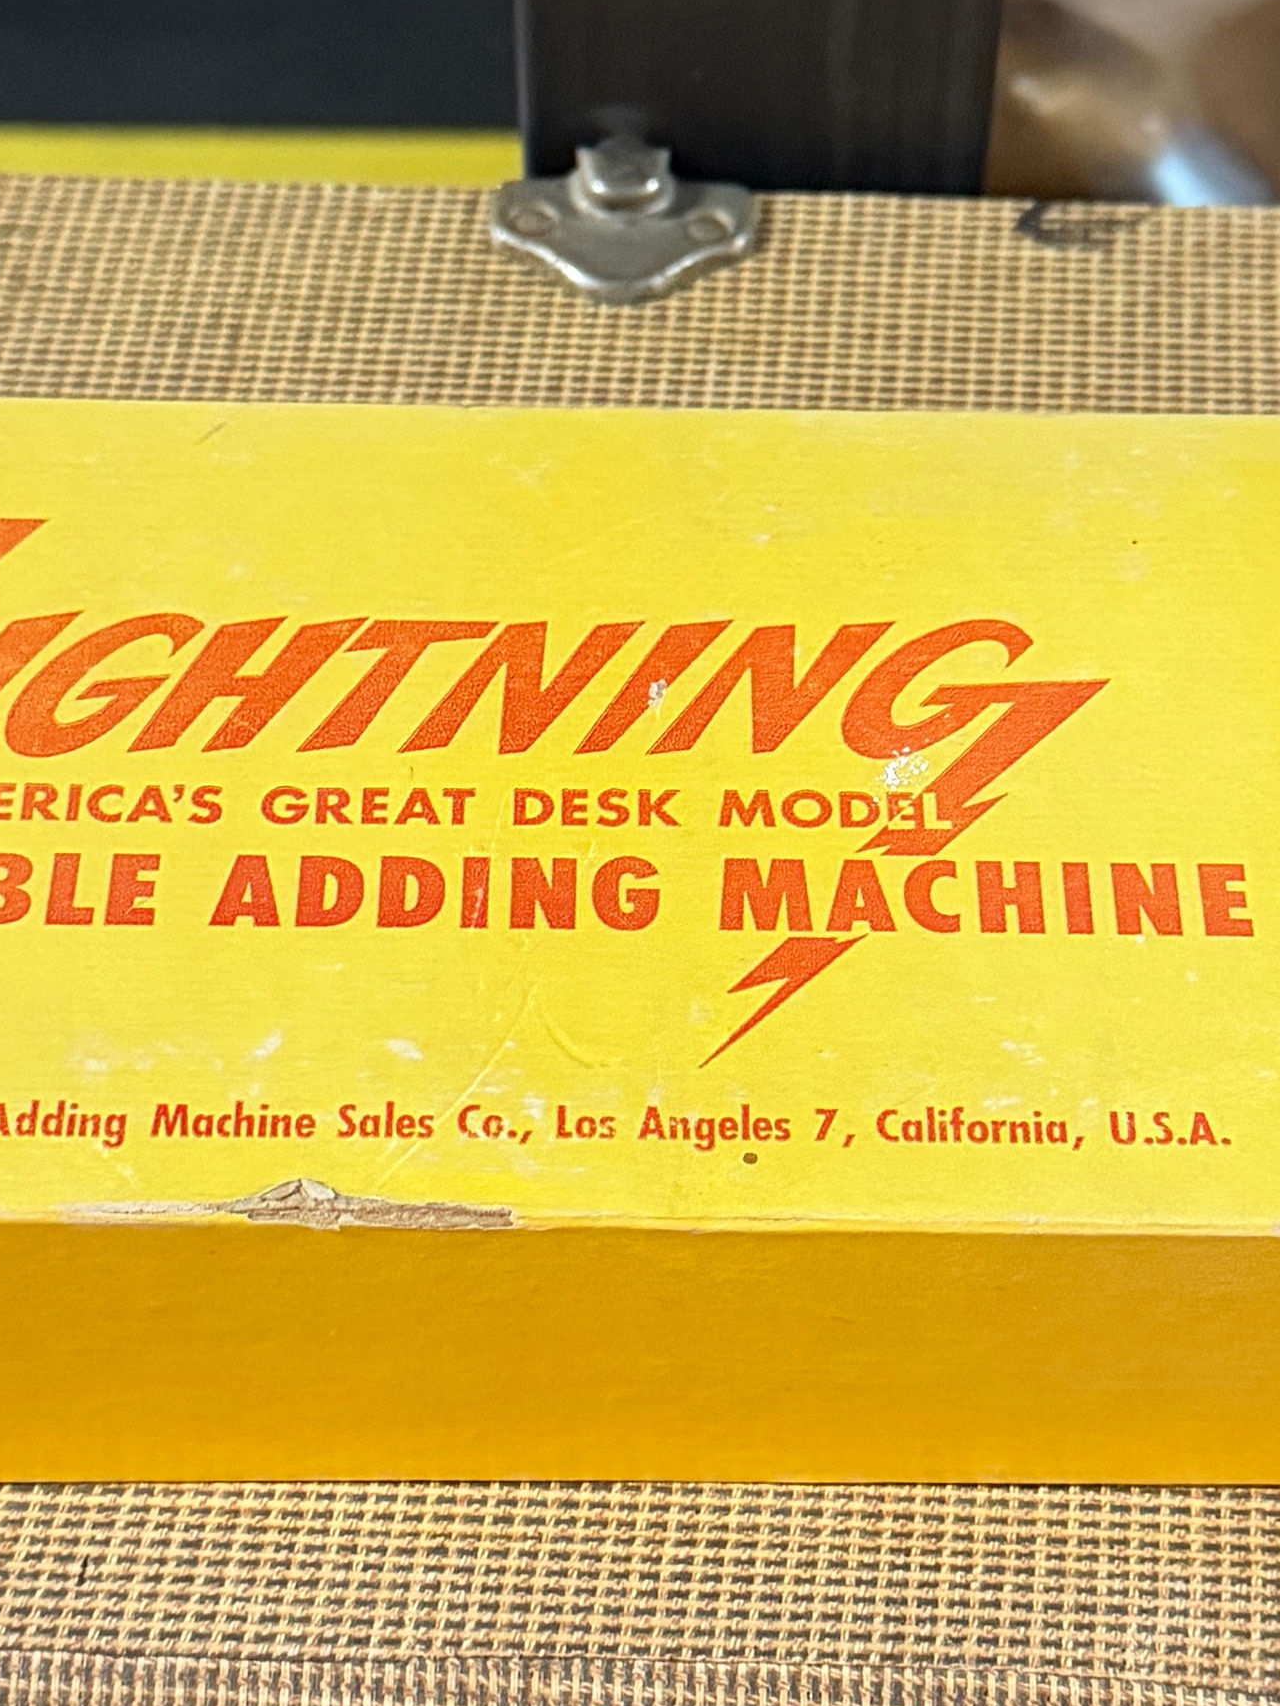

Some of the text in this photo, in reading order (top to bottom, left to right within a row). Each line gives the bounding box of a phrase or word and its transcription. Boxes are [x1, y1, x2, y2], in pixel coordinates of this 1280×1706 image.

[260, 784, 476, 827] GREAT
[512, 787, 681, 828] DESK
[719, 789, 954, 832] MODEL
[208, 853, 662, 931] ADDING
[719, 858, 1256, 938] MACHINE
[150, 1102, 316, 1140] Machine
[336, 1102, 435, 1141] Sales
[456, 1103, 535, 1145] Co.,
[556, 1105, 617, 1140] Los
[637, 1104, 792, 1150] Angeles
[813, 1107, 856, 1151] 7,
[876, 1108, 1084, 1152] California,
[1108, 1111, 1233, 1147] U.S.A.
